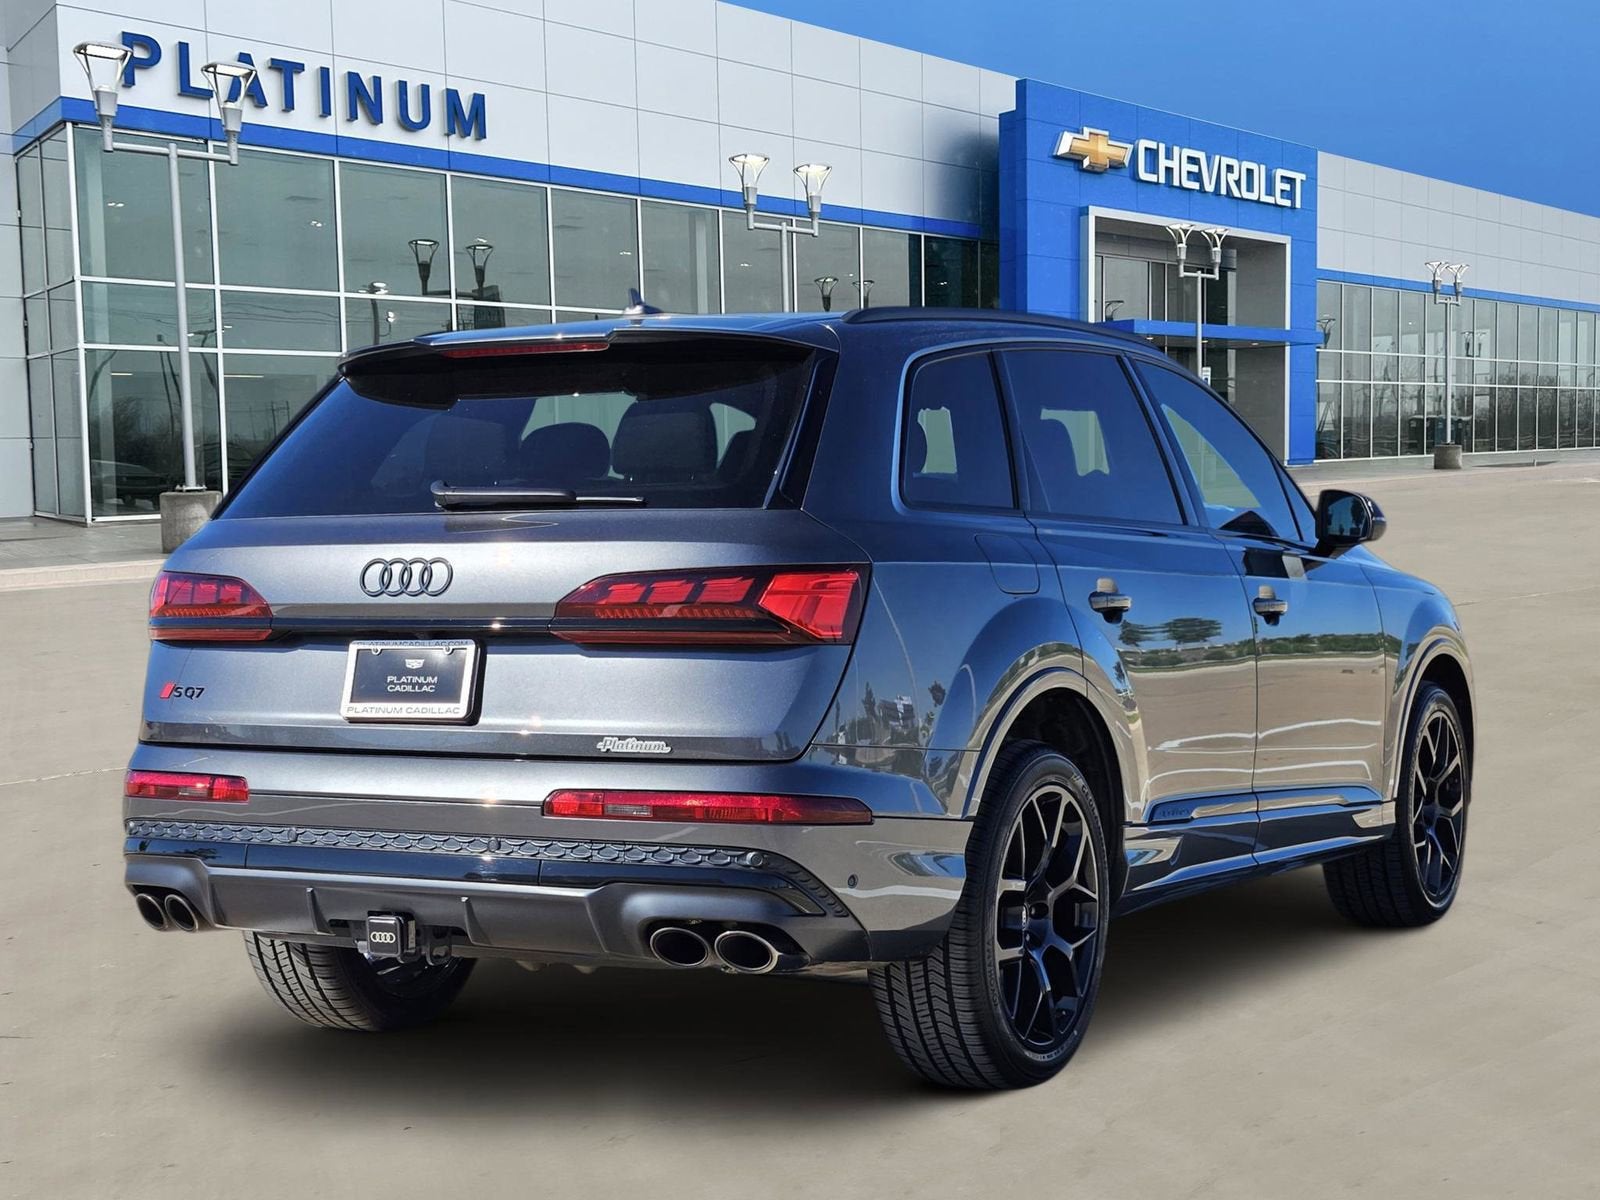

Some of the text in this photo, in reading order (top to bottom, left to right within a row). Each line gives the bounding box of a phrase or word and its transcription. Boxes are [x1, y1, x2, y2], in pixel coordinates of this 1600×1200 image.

[121, 31, 487, 140] PLATINUM
[1137, 138, 1306, 209] CHEVROLET
[387, 675, 438, 684] PLATINUM
[173, 686, 205, 700] SQ7
[387, 685, 436, 693] CADILLAC
[346, 706, 461, 715] PLATINUM CADILLAC
[597, 737, 671, 753] Platinum
